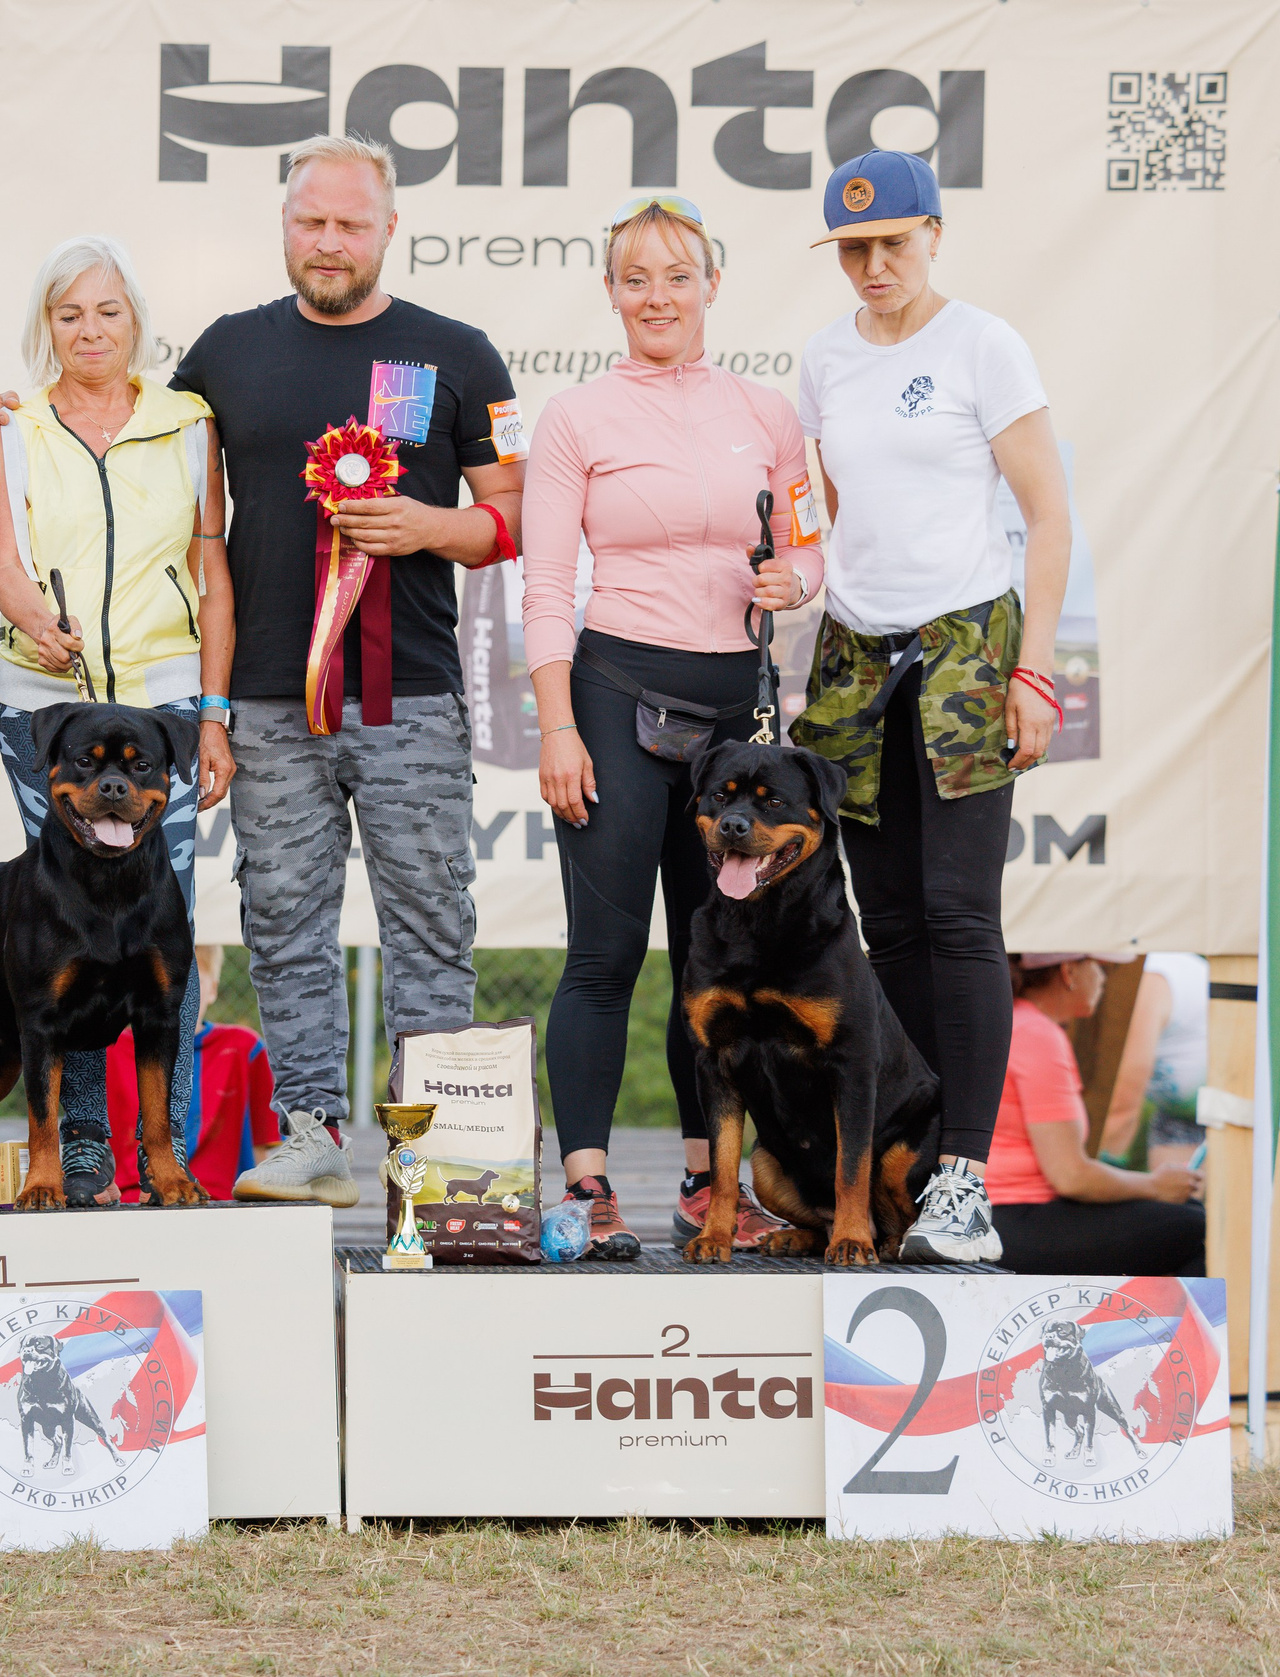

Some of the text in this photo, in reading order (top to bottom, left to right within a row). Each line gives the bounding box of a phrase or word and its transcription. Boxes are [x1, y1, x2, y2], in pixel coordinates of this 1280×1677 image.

[159, 39, 986, 190] Hanta
[894, 405, 935, 419] ОЛЬБУРД
[424, 1079, 513, 1098] Hanta
[433, 1122, 505, 1132] SMALL/MEDIUM
[661, 1324, 690, 1357] 2
[55, 1303, 128, 1337] КЛУБ
[133, 1340, 171, 1455] РОССИИ
[980, 1289, 1194, 1448] РОТВЕЙЛЕР КЛУБ РОССИИ
[533, 1368, 813, 1421] Hanta
[842, 1285, 960, 1496] 2
[619, 1430, 728, 1450] premium
[10, 1474, 129, 1509] РКФ-НКПР
[1032, 1467, 1151, 1502] РКФ-НКПР
